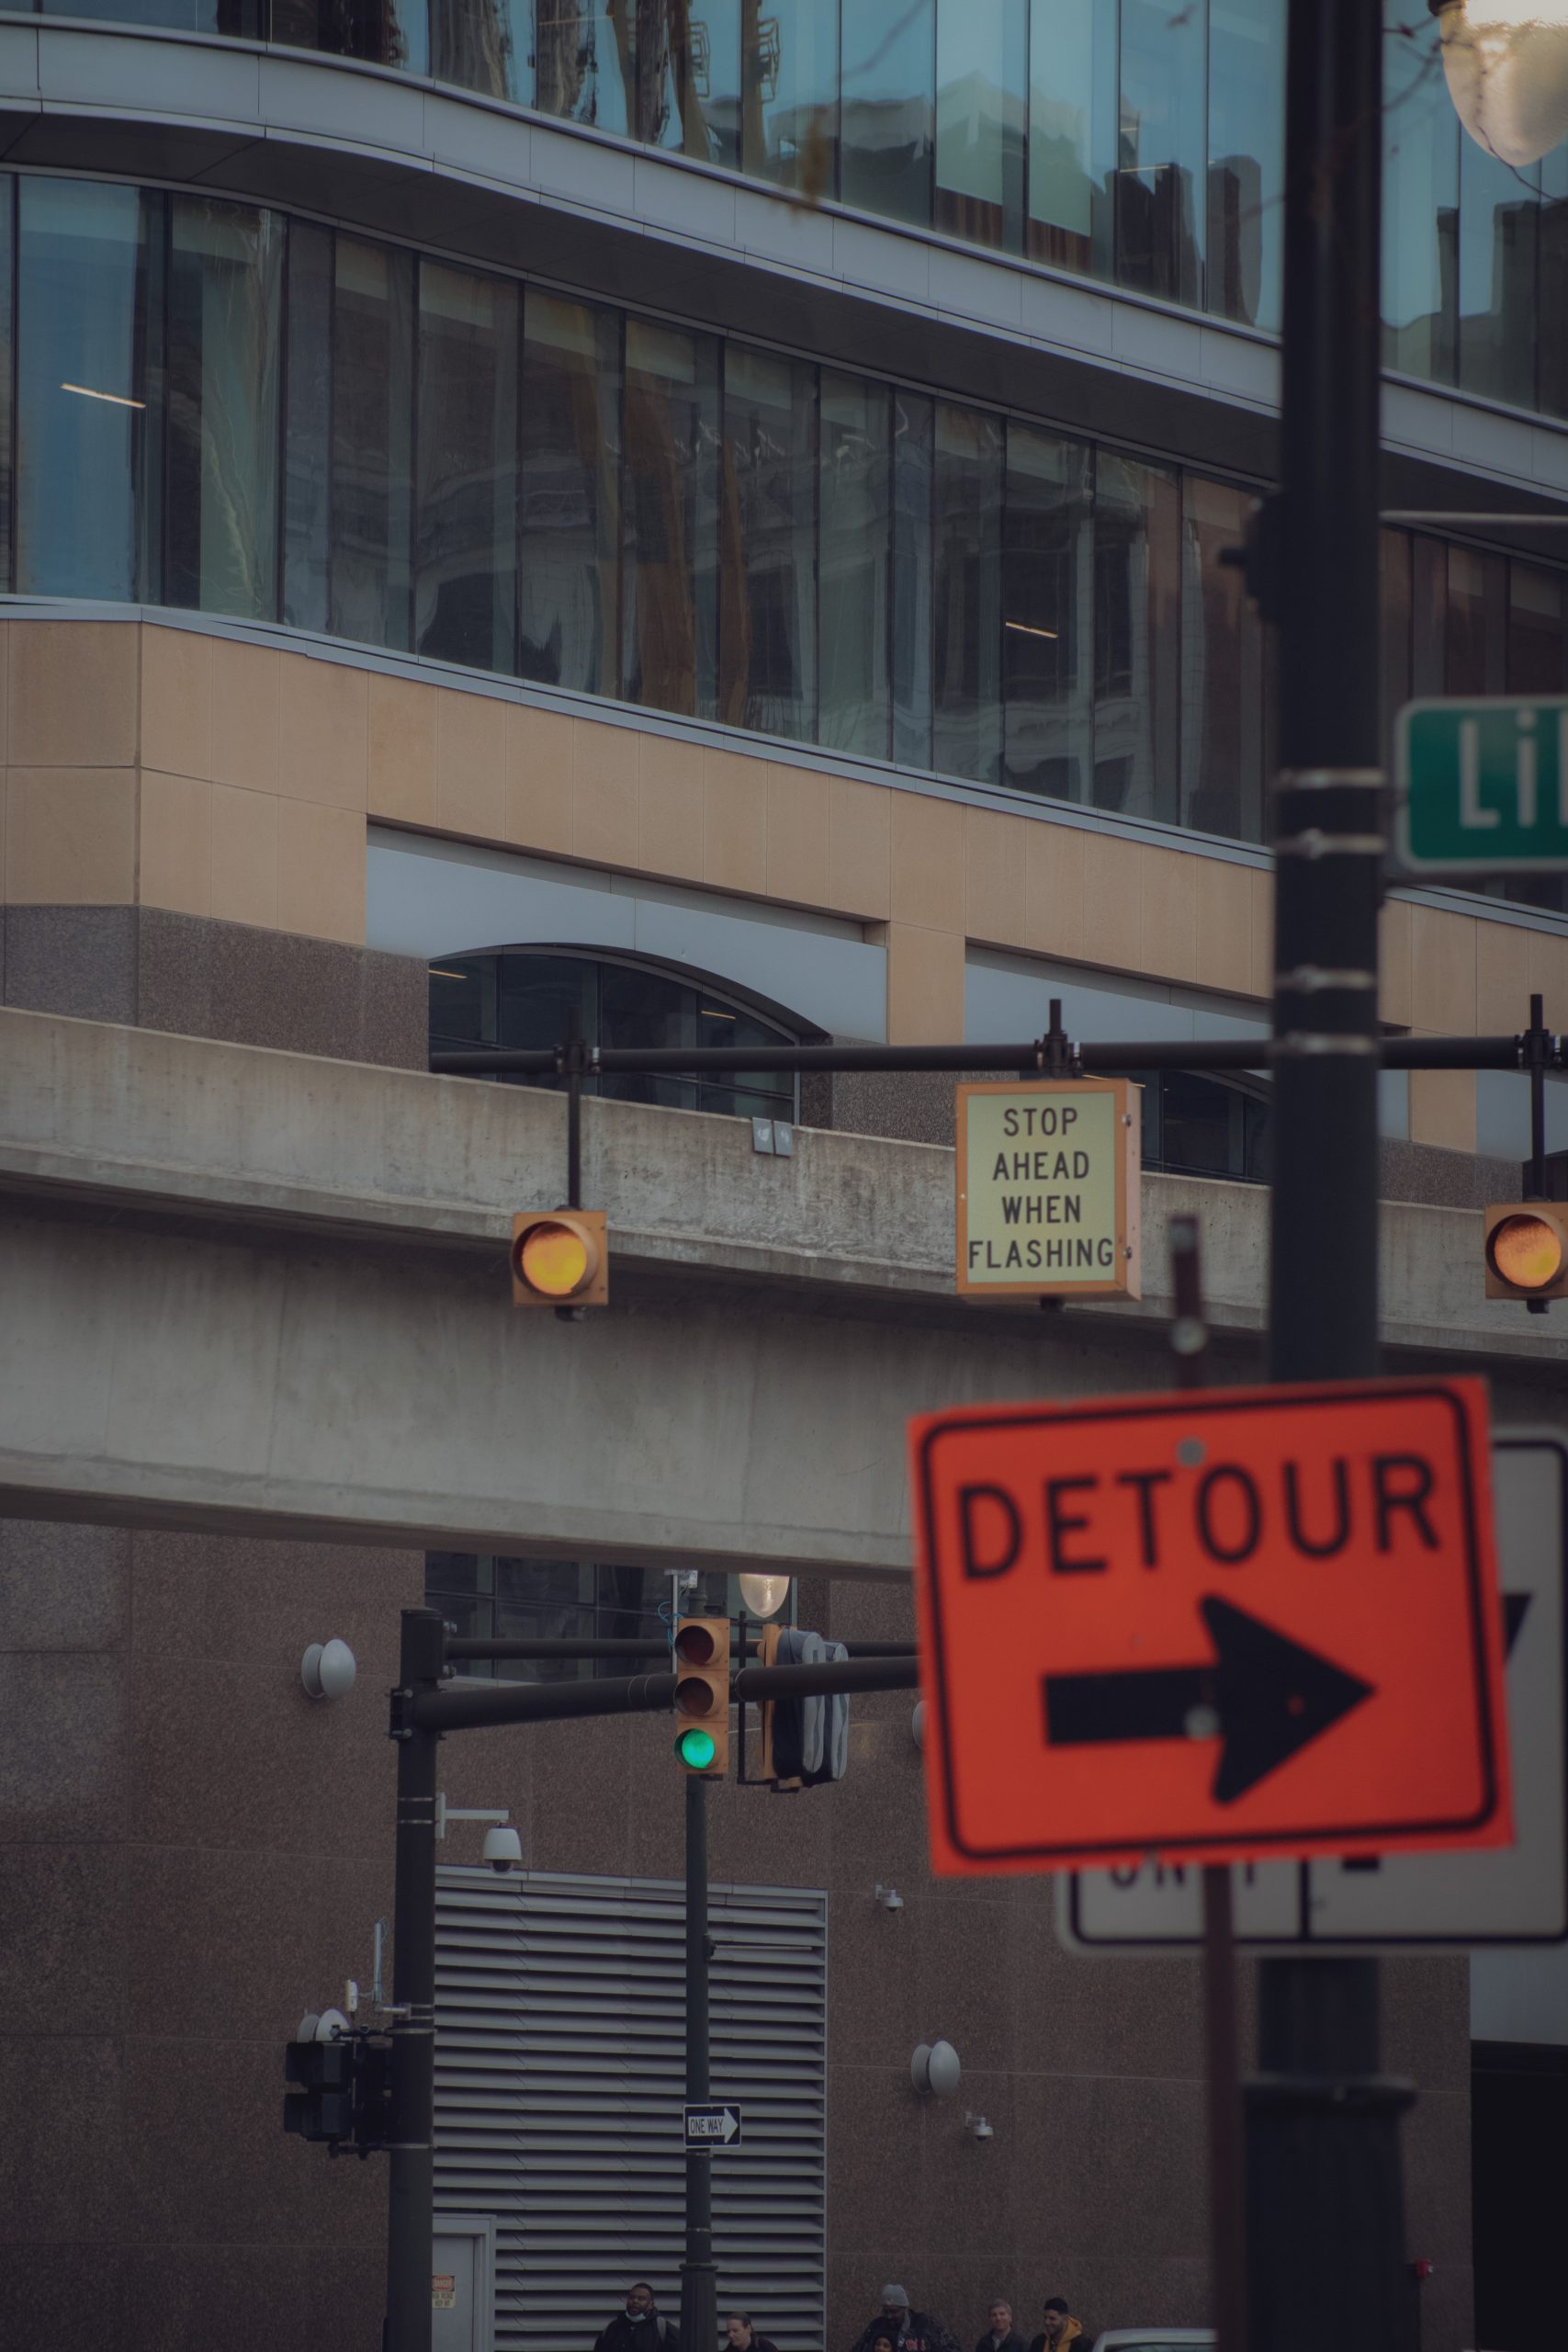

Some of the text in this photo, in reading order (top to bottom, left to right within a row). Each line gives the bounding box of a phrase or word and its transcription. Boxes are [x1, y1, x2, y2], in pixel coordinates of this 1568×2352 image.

[1003, 1107, 1078, 1136] STOP
[992, 1151, 1090, 1181] AHEAD
[1001, 1194, 1081, 1224] WHEN
[968, 1238, 1114, 1269] FLASHING
[956, 1453, 1440, 1583] DETOUR
[690, 2118, 724, 2134] ONE WAY
